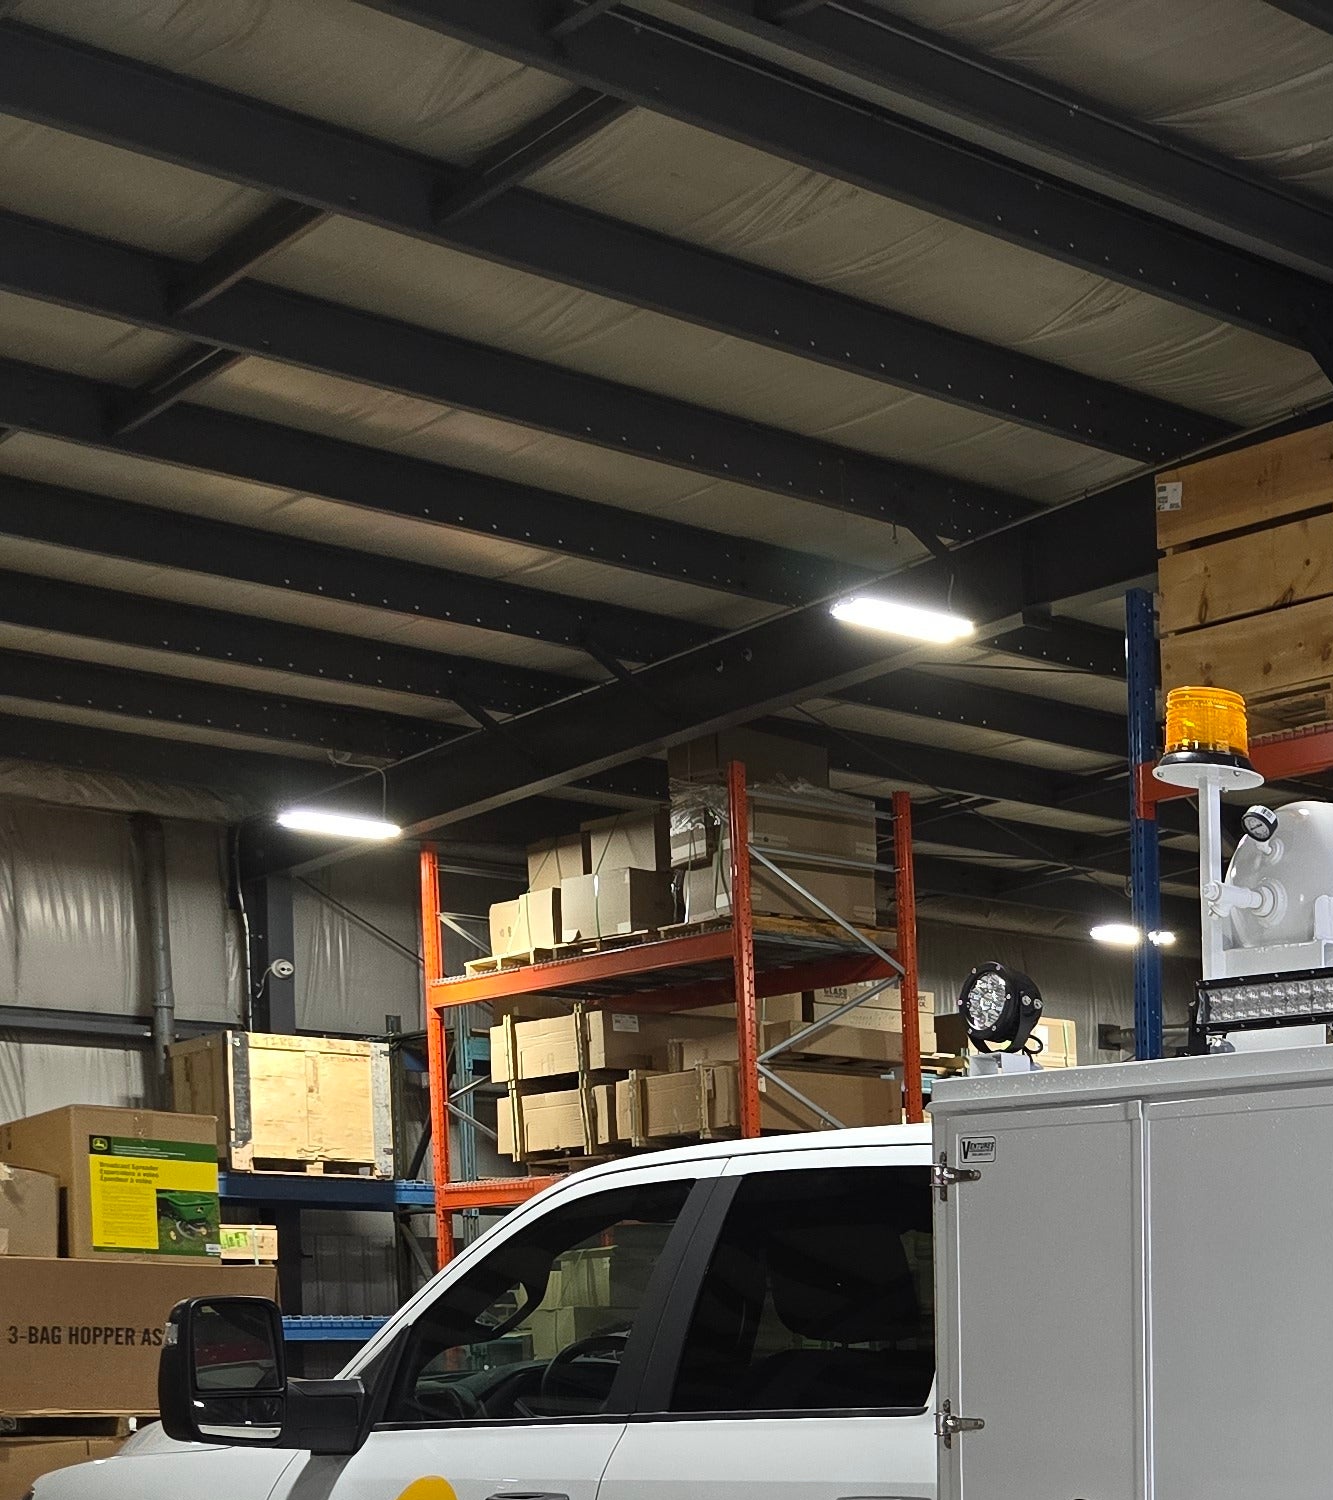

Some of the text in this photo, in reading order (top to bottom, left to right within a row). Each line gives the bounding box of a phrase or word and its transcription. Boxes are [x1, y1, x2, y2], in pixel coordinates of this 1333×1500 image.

[8, 1325, 165, 1346] 3-BAG HOPPER AS
